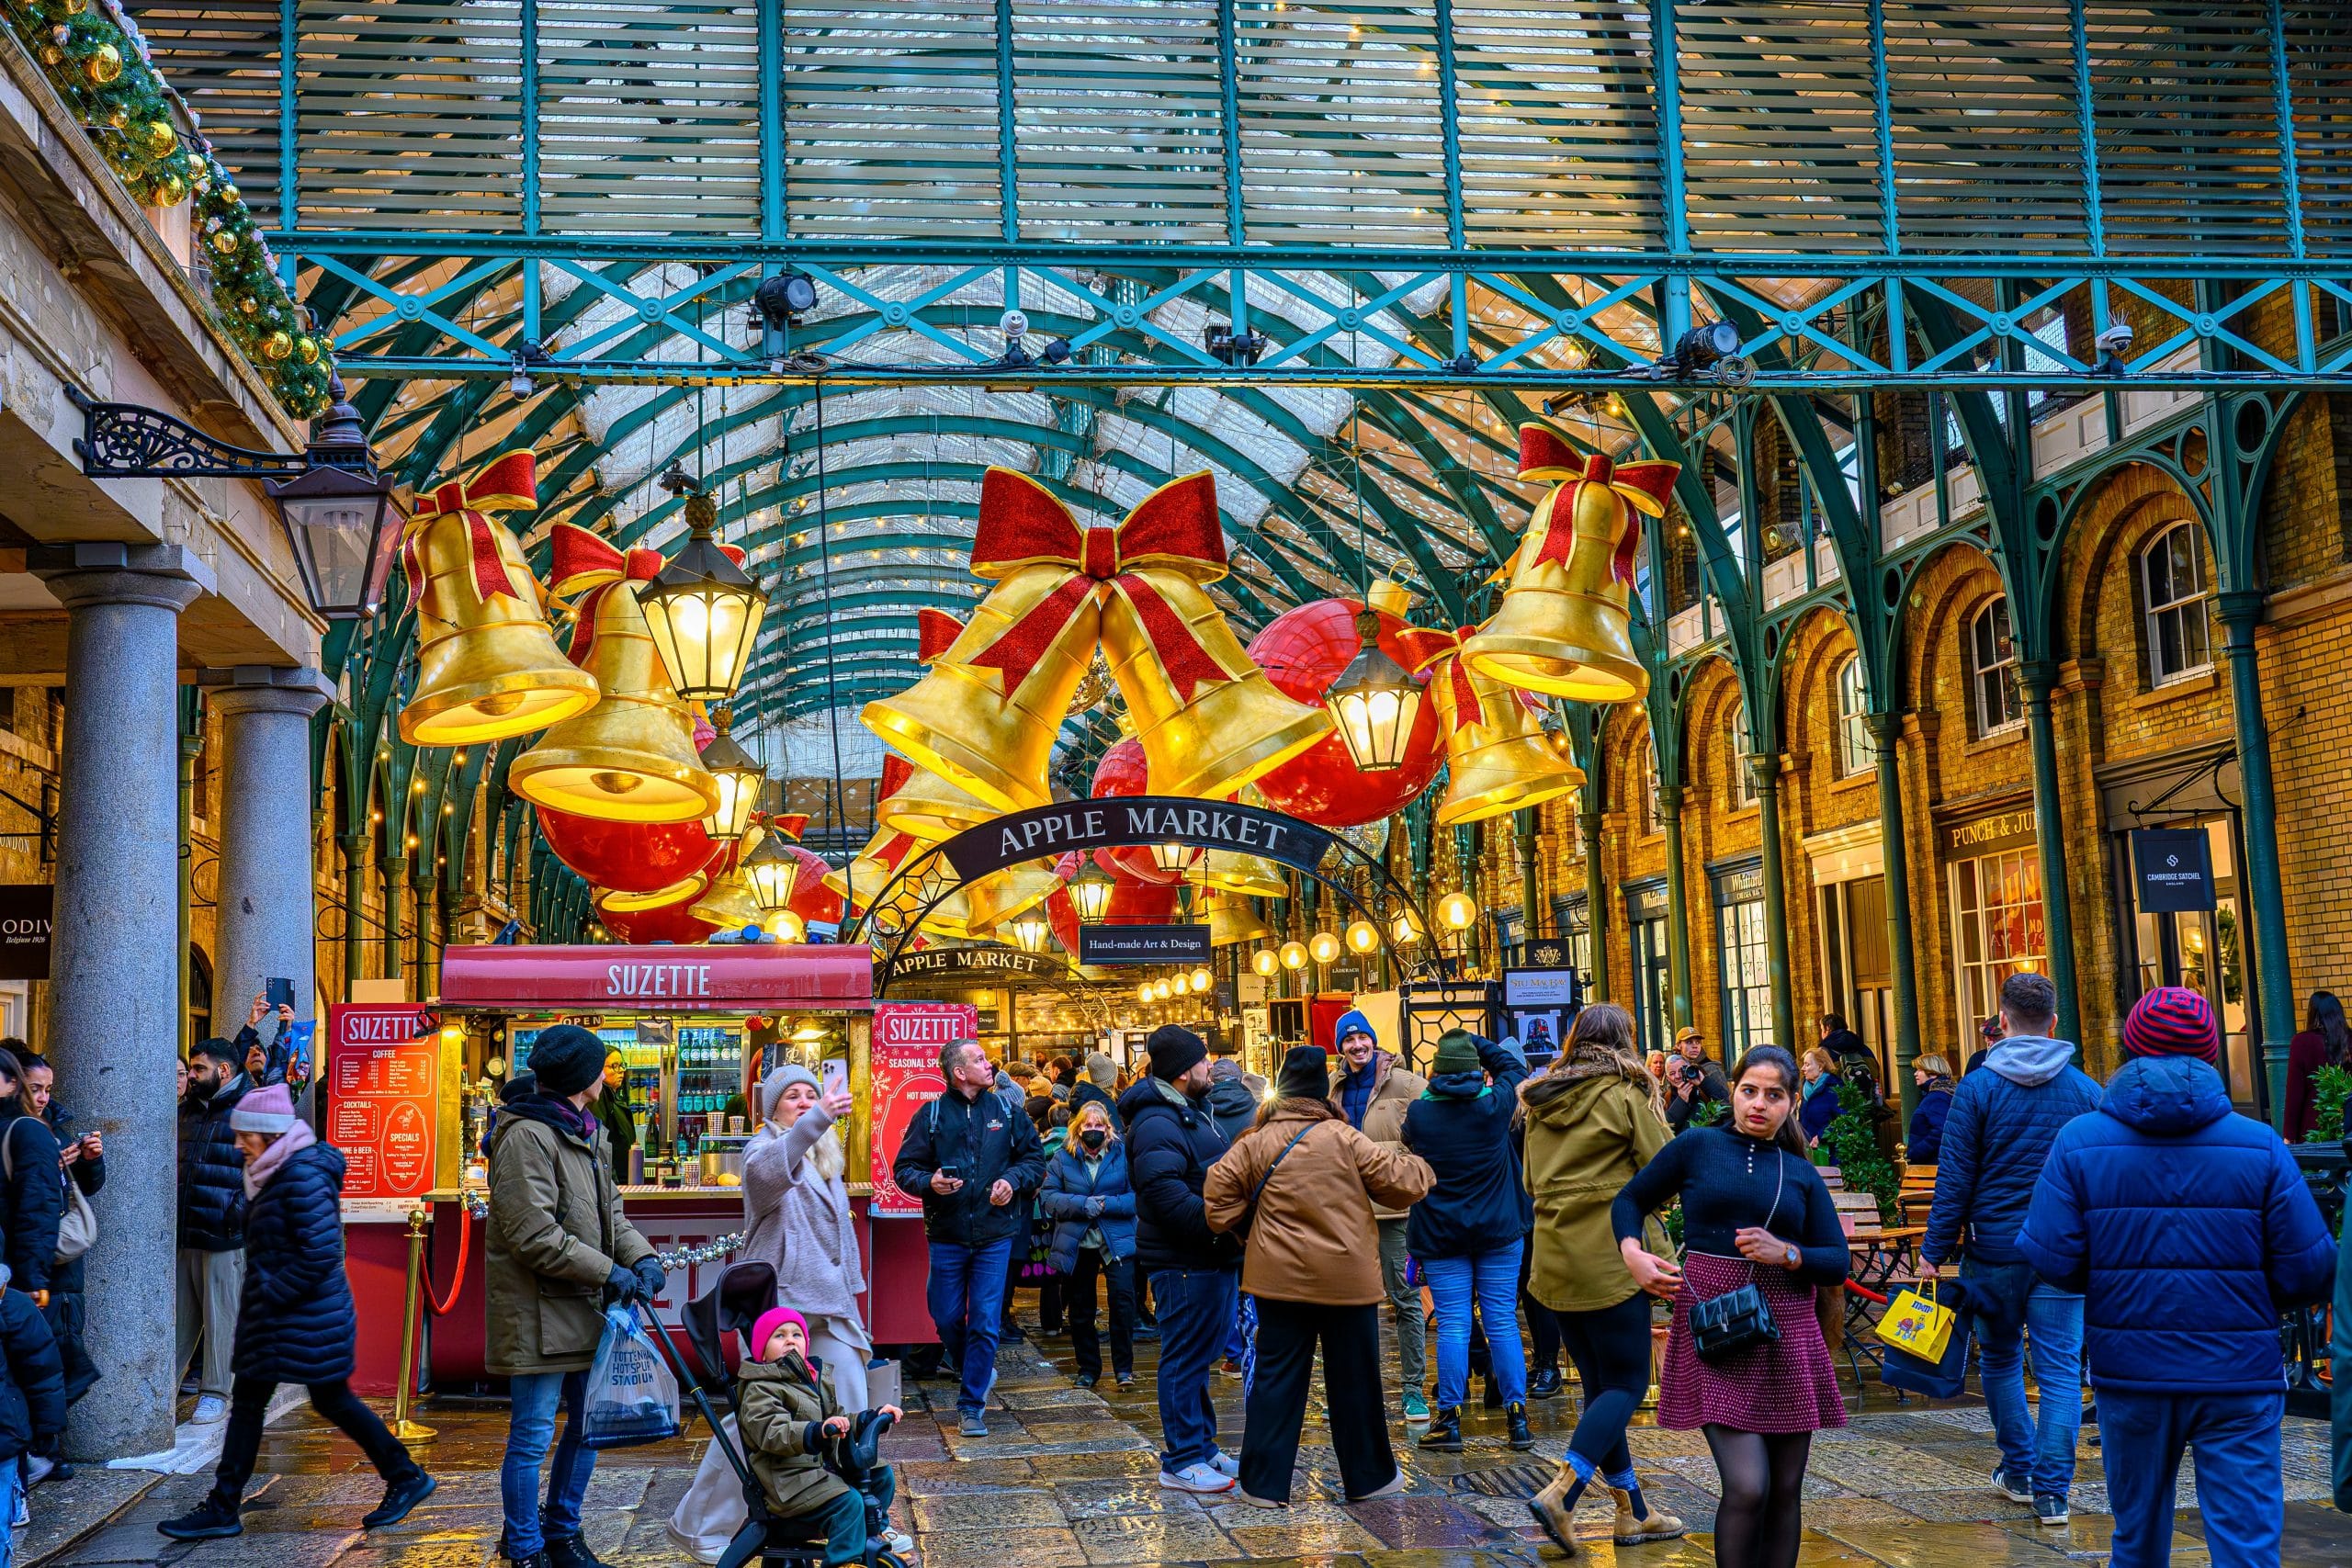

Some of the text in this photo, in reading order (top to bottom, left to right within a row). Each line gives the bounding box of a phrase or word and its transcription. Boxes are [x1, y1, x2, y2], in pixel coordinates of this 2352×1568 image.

[1000, 807, 1288, 857] APPLE MARKET
[1951, 820, 1995, 848] PUNCH
[2000, 818, 2010, 836] &
[0, 837, 29, 853] ONDON
[2147, 872, 2201, 882] CAMBRIDGE SATCHEL
[2, 919, 53, 934] ODIV
[6, 936, 31, 944] Belgium
[1090, 939, 1202, 951] Hand-made Art & Design
[892, 952, 1038, 976] APPLE MARKET
[606, 964, 711, 996] SUZETTE
[562, 1017, 602, 1026] OPEN
[889, 1018, 960, 1041] SUZETTE
[372, 1050, 396, 1059] COFFEE
[888, 1058, 941, 1068] SEASONAL SPE
[907, 1091, 919, 1100] HOT
[343, 1100, 372, 1109] COCKTAILS
[390, 1134, 420, 1142] SPECIALS
[613, 1350, 651, 1362] TOTTENHA
[612, 1360, 650, 1374] HOTSPUR
[612, 1372, 654, 1385] STADIUM
